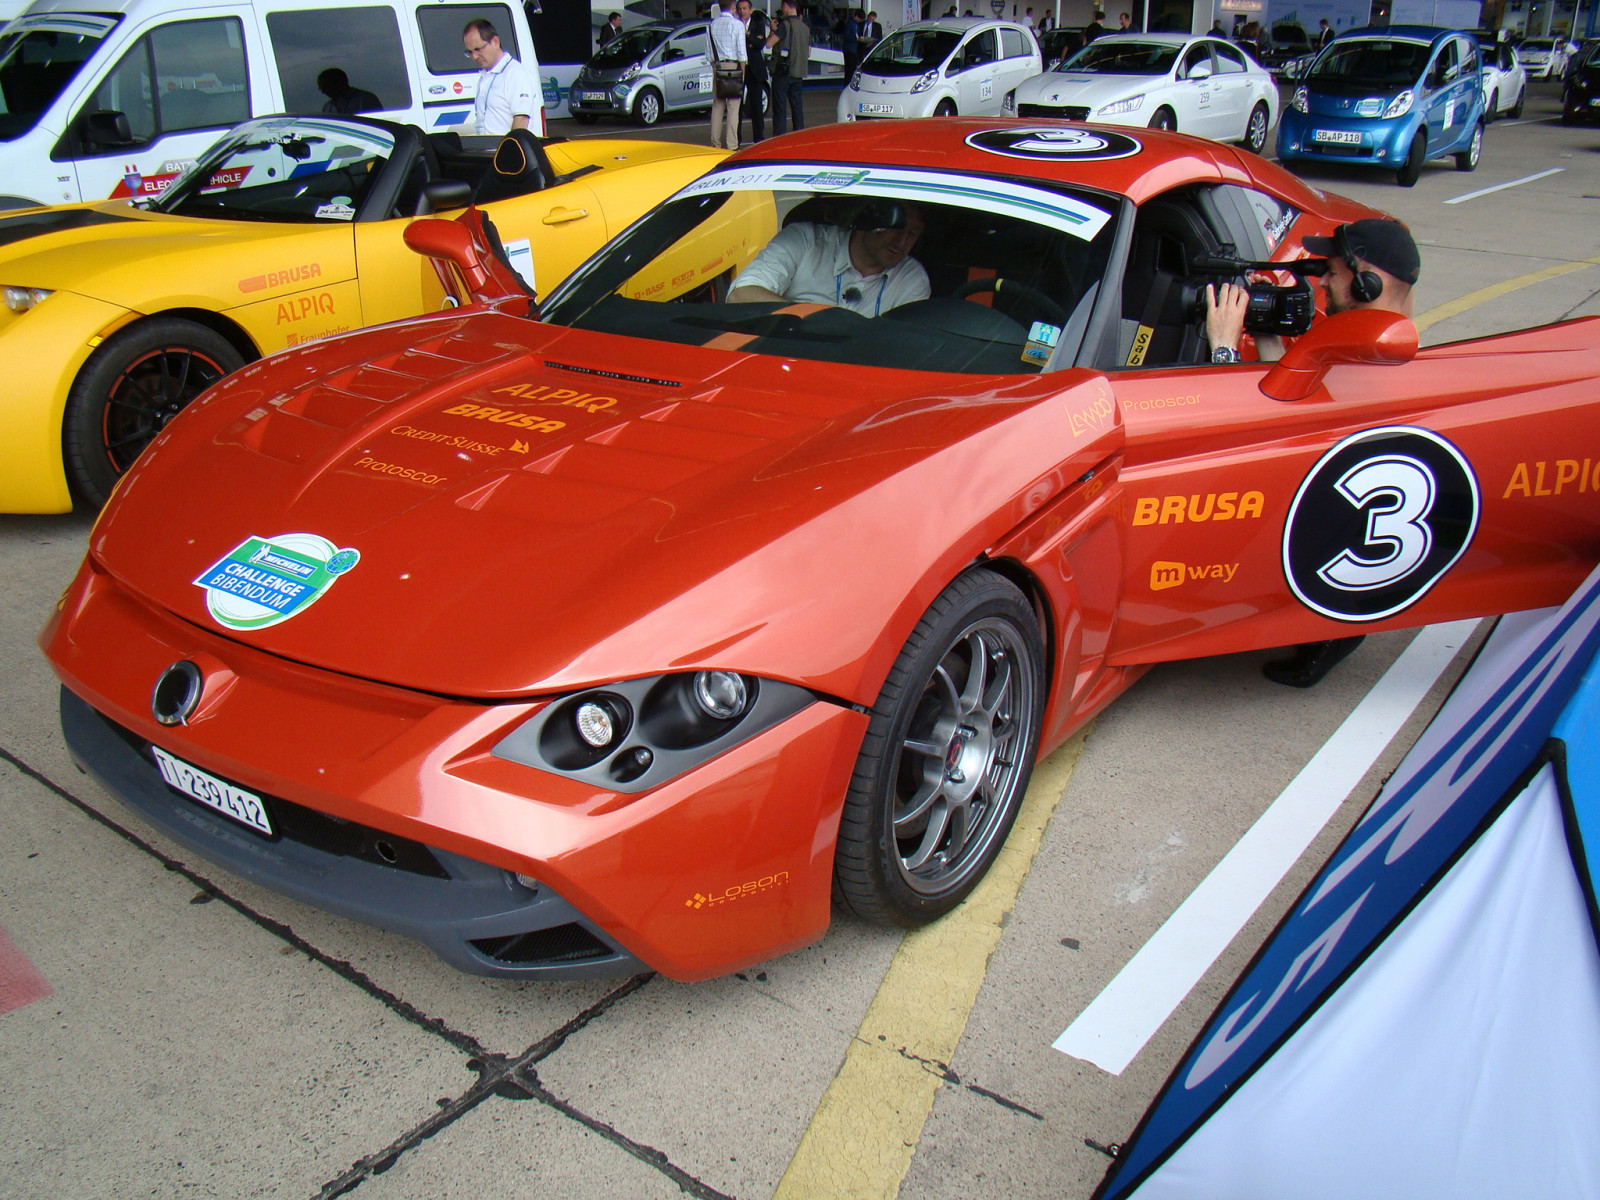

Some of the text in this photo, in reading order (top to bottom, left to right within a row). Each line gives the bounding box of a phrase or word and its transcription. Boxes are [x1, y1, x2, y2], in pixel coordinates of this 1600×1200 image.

[981, 86, 992, 97] 134
[1200, 91, 1210, 102] 259
[881, 105, 893, 113] 117
[998, 126, 1109, 152] 3
[1316, 131, 1360, 143] SB AP 118
[731, 174, 774, 186] 2011
[267, 263, 322, 288] BRUSA
[645, 282, 665, 296] BASF
[276, 292, 336, 325] ALPIQ
[491, 383, 618, 414] ALPIQ
[1123, 394, 1202, 411] Protoscar
[442, 403, 567, 433] BRUSA
[390, 425, 505, 456] CREDIT SUISSE
[354, 456, 448, 486] Protoscar
[1502, 457, 1600, 499] ALPI
[1132, 491, 1265, 527] BRUSA
[1316, 454, 1437, 592] 3
[263, 554, 313, 576] MICHELIN
[210, 573, 292, 609] BIBENDUM
[224, 562, 306, 597] CHALLENGE
